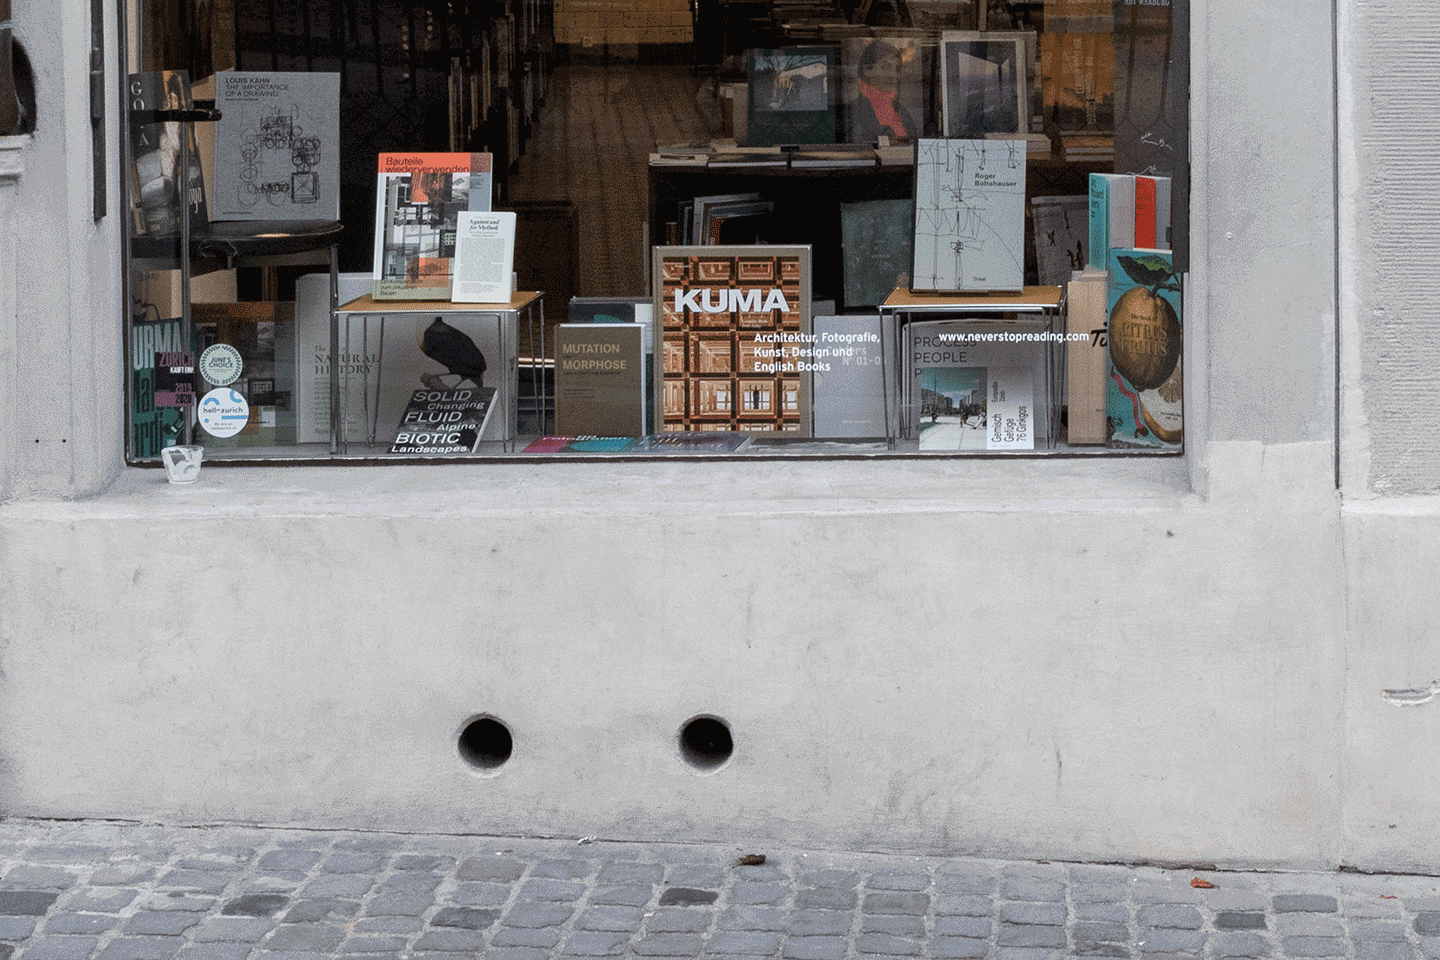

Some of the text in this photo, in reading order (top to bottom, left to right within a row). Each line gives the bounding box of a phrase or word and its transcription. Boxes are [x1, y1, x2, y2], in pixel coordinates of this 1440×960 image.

[386, 157, 424, 166] Bauteile
[674, 288, 790, 313] KUMA
[754, 332, 880, 344] Architektur, Fotografie,
[938, 331, 1090, 344] www.neverstopreading.com
[562, 344, 620, 354] MUTATION
[754, 346, 853, 358] Kunst, Design und
[914, 352, 968, 363] PEOPLE
[562, 360, 627, 370] MORPHOSE
[754, 361, 831, 374] English Books
[413, 390, 472, 402] SOLID
[427, 402, 486, 410] Changing
[404, 411, 463, 423] FLUID
[436, 423, 476, 432] Alpine
[991, 414, 1002, 442] Gemisch
[1004, 418, 1016, 442] Gefüge
[395, 432, 462, 444] BIOTIC
[391, 445, 468, 454] Landscapes
